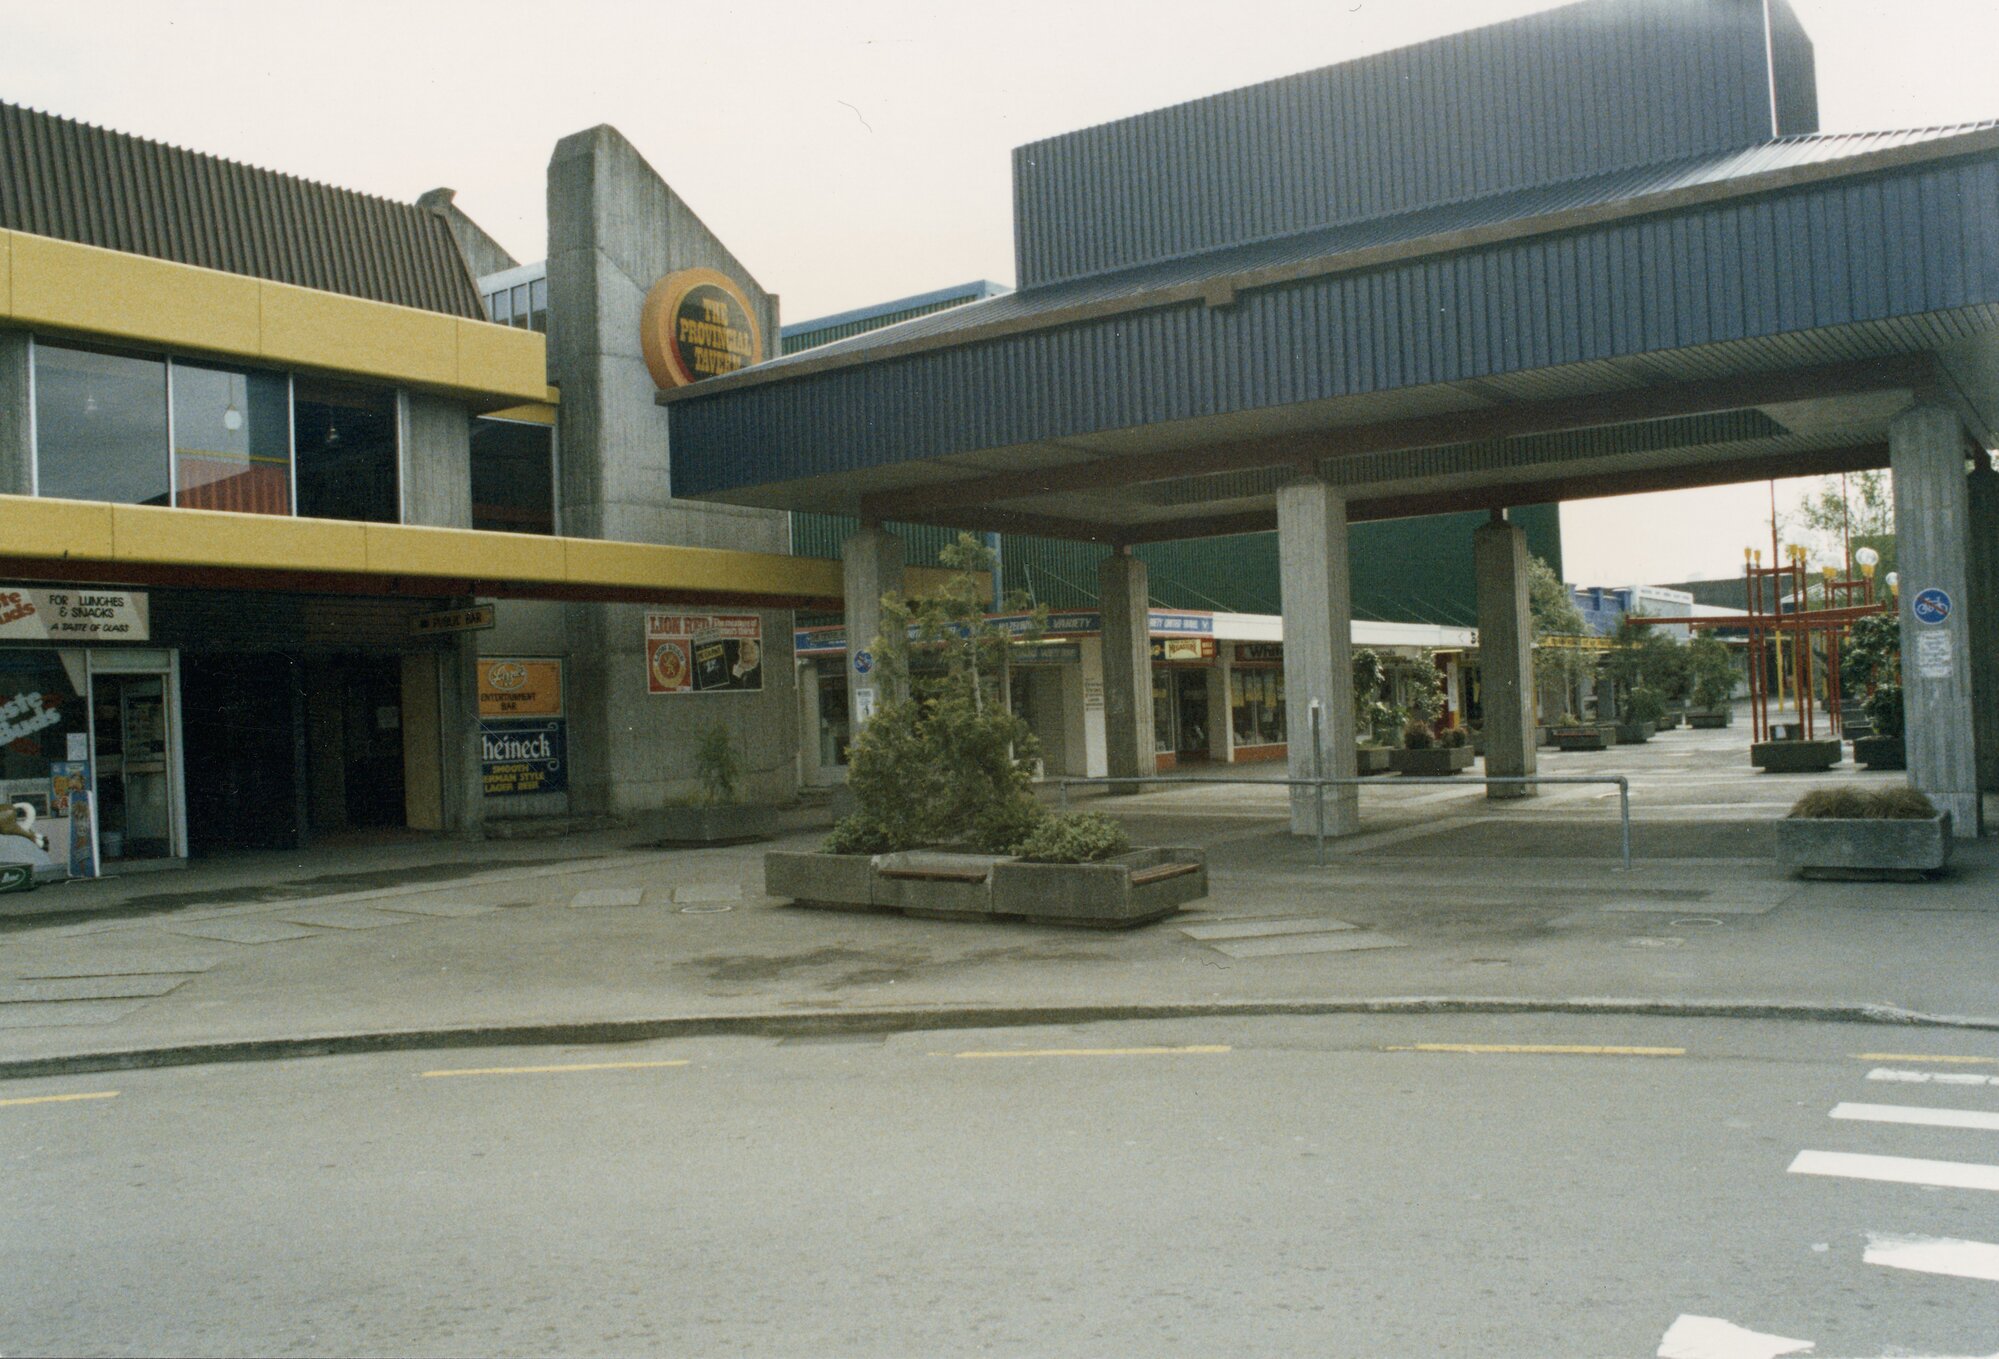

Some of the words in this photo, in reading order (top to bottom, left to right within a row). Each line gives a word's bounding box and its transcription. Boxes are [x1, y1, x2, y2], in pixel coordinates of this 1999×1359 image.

[703, 298, 728, 326] THE
[49, 595, 69, 606] FOR
[79, 596, 124, 607] LUNCHES
[59, 608, 68, 618] &
[71, 607, 115, 618] SNACKS
[51, 623, 59, 631] A
[62, 623, 87, 632] TASTE
[90, 623, 101, 632] OF
[102, 624, 130, 632] CLASS
[649, 616, 682, 634] LION
[1053, 618, 1092, 628] VARIETY
[500, 702, 518, 711] BAR
[481, 733, 551, 761] heineck
[519, 772, 545, 781] STYLE
